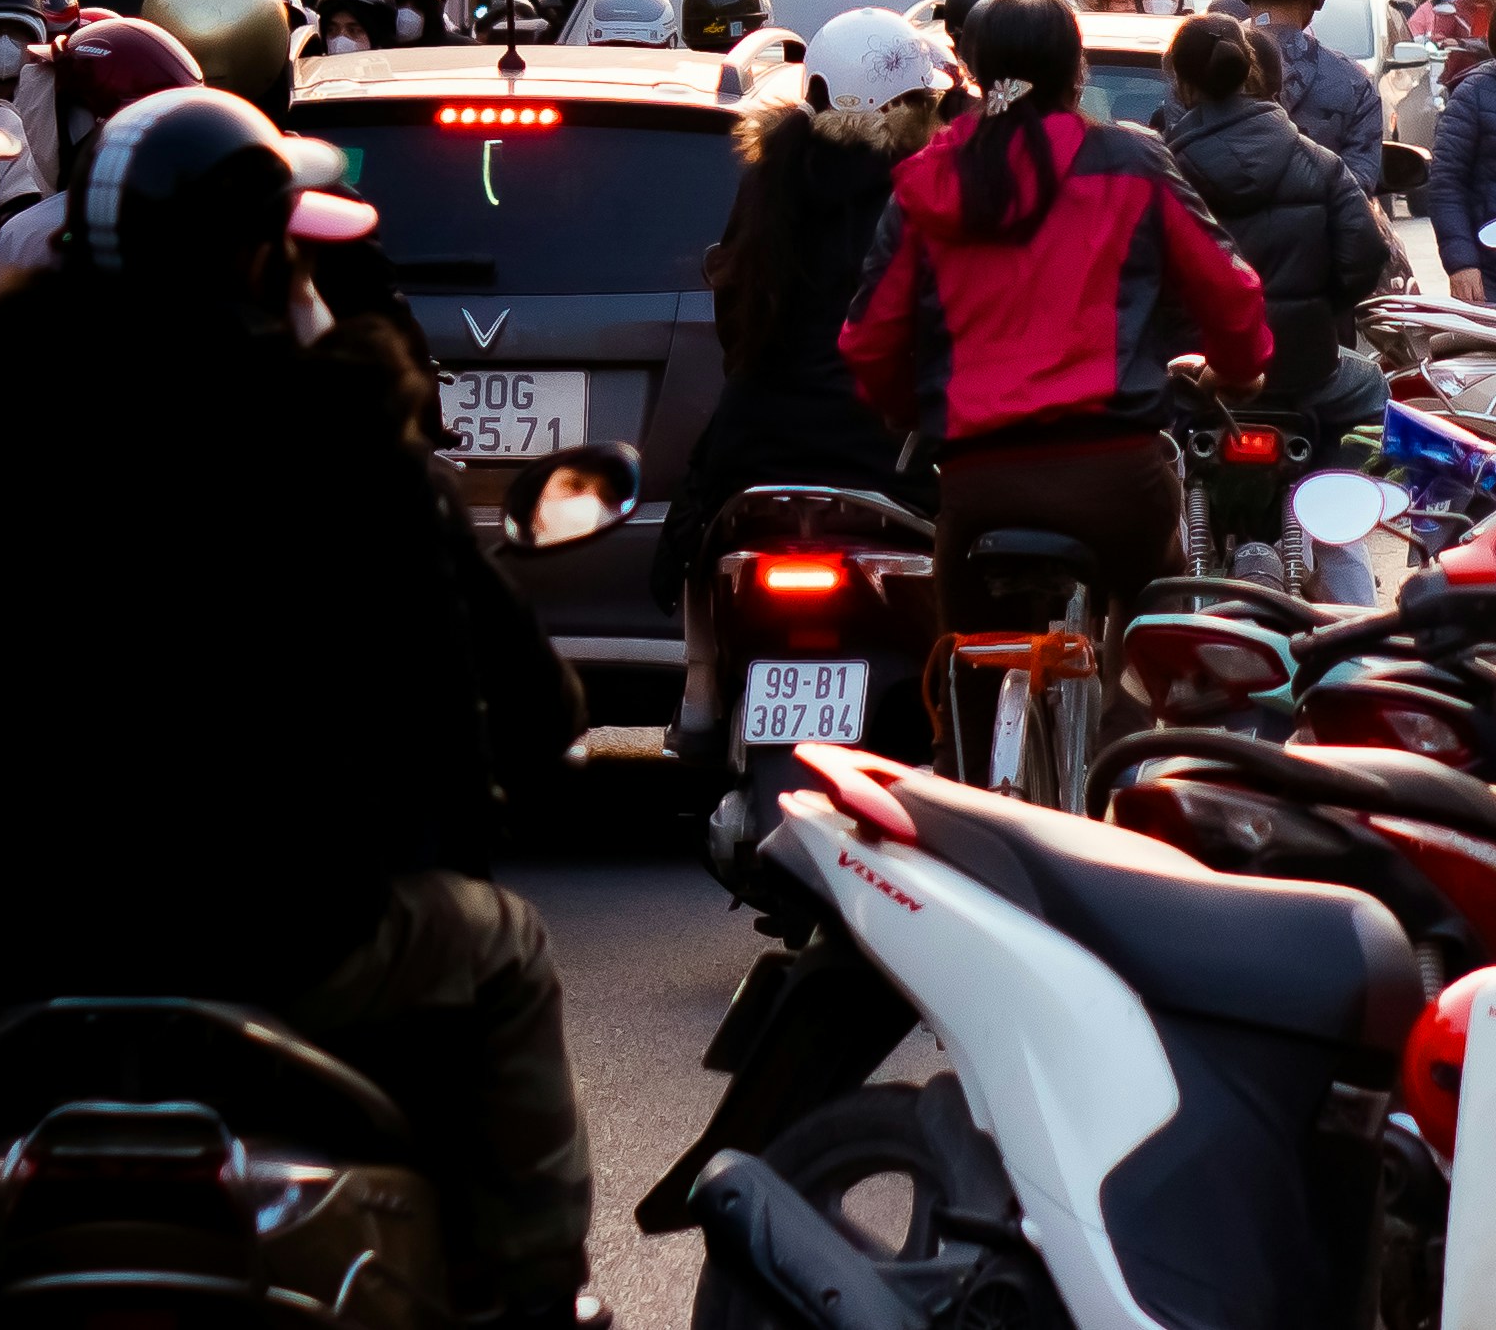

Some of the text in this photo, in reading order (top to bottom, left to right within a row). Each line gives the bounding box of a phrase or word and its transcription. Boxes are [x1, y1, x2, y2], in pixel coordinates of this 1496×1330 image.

[458, 374, 534, 410] 30G
[451, 416, 561, 452] 65.71
[765, 667, 847, 700] 99-B1
[751, 704, 853, 737] 387.84
